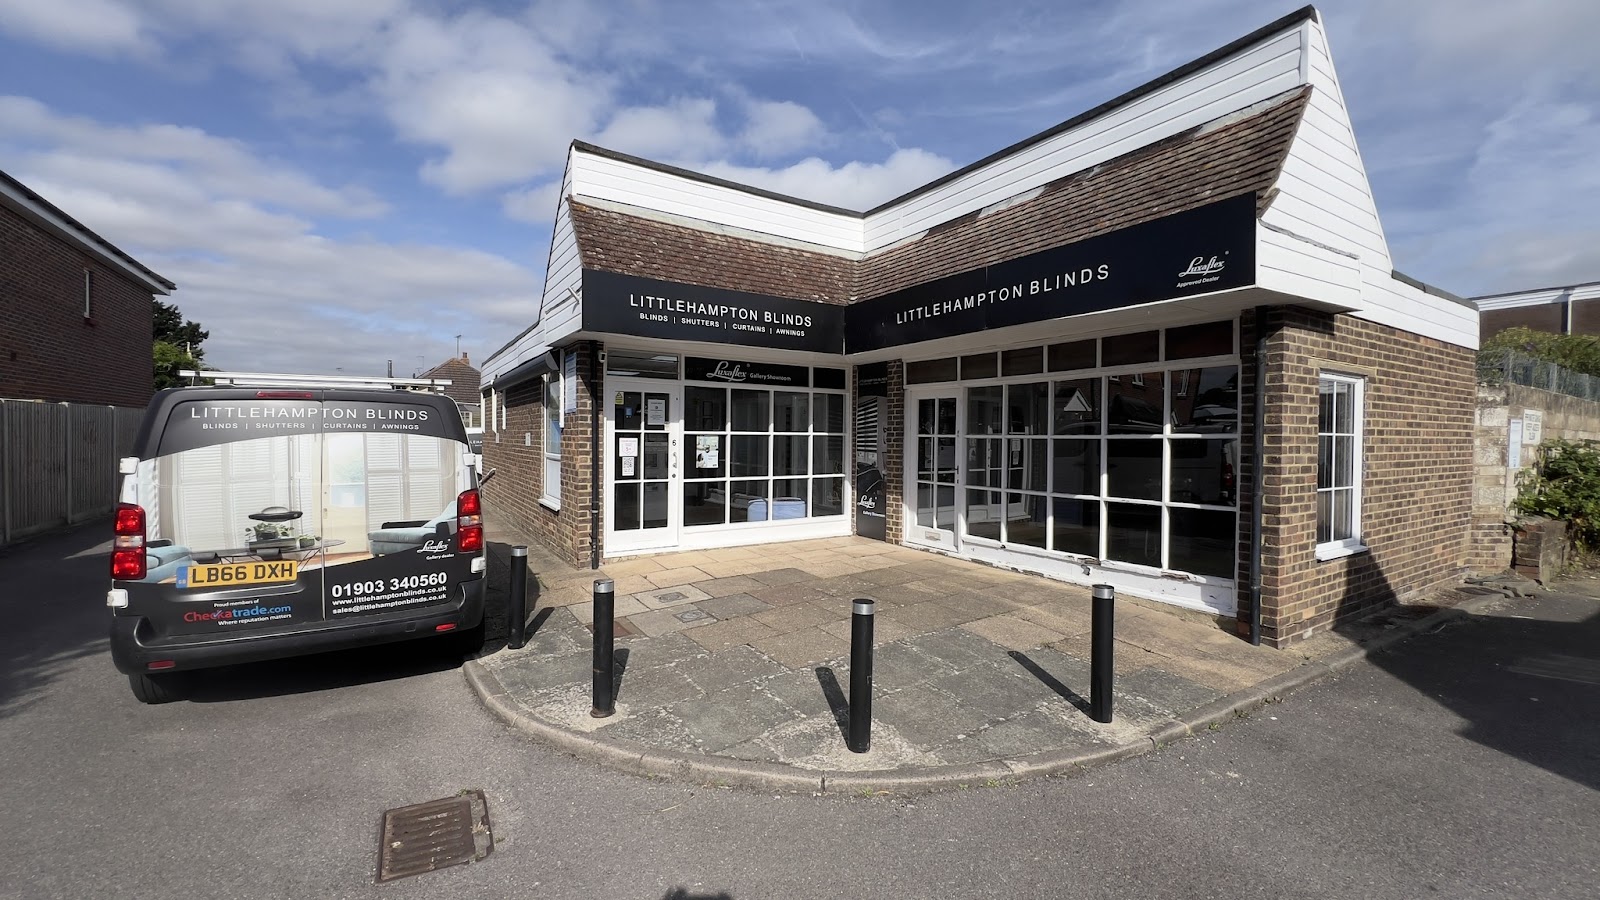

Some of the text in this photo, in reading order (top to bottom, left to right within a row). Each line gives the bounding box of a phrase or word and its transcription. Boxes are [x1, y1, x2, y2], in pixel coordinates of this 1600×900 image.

[1178, 256, 1225, 277] Luxaflex
[1176, 276, 1220, 288] Approved Dealer
[896, 264, 1110, 325] LITTLEHAMPTON BLINDS
[630, 294, 812, 327] LITTLEHAMPTON BLINDS
[640, 313, 805, 337] BLINDS SHUTTERS CURTAINS AWNINGS
[706, 361, 747, 382] Luxaflex
[749, 372, 767, 380] Gallery
[191, 407, 428, 421] LITTLEHAMPTON BLINDS
[202, 422, 238, 430] BLINDS
[192, 563, 293, 583] LB66 DXH
[331, 572, 447, 598] 01903 340560
[332, 586, 447, 606] www.littlehamptonblinds.co.uk
[332, 593, 447, 614] sales@littlehamptonblinds.co.uk
[184, 605, 292, 622] Checkatrade.com
[238, 616, 270, 624] reputation
